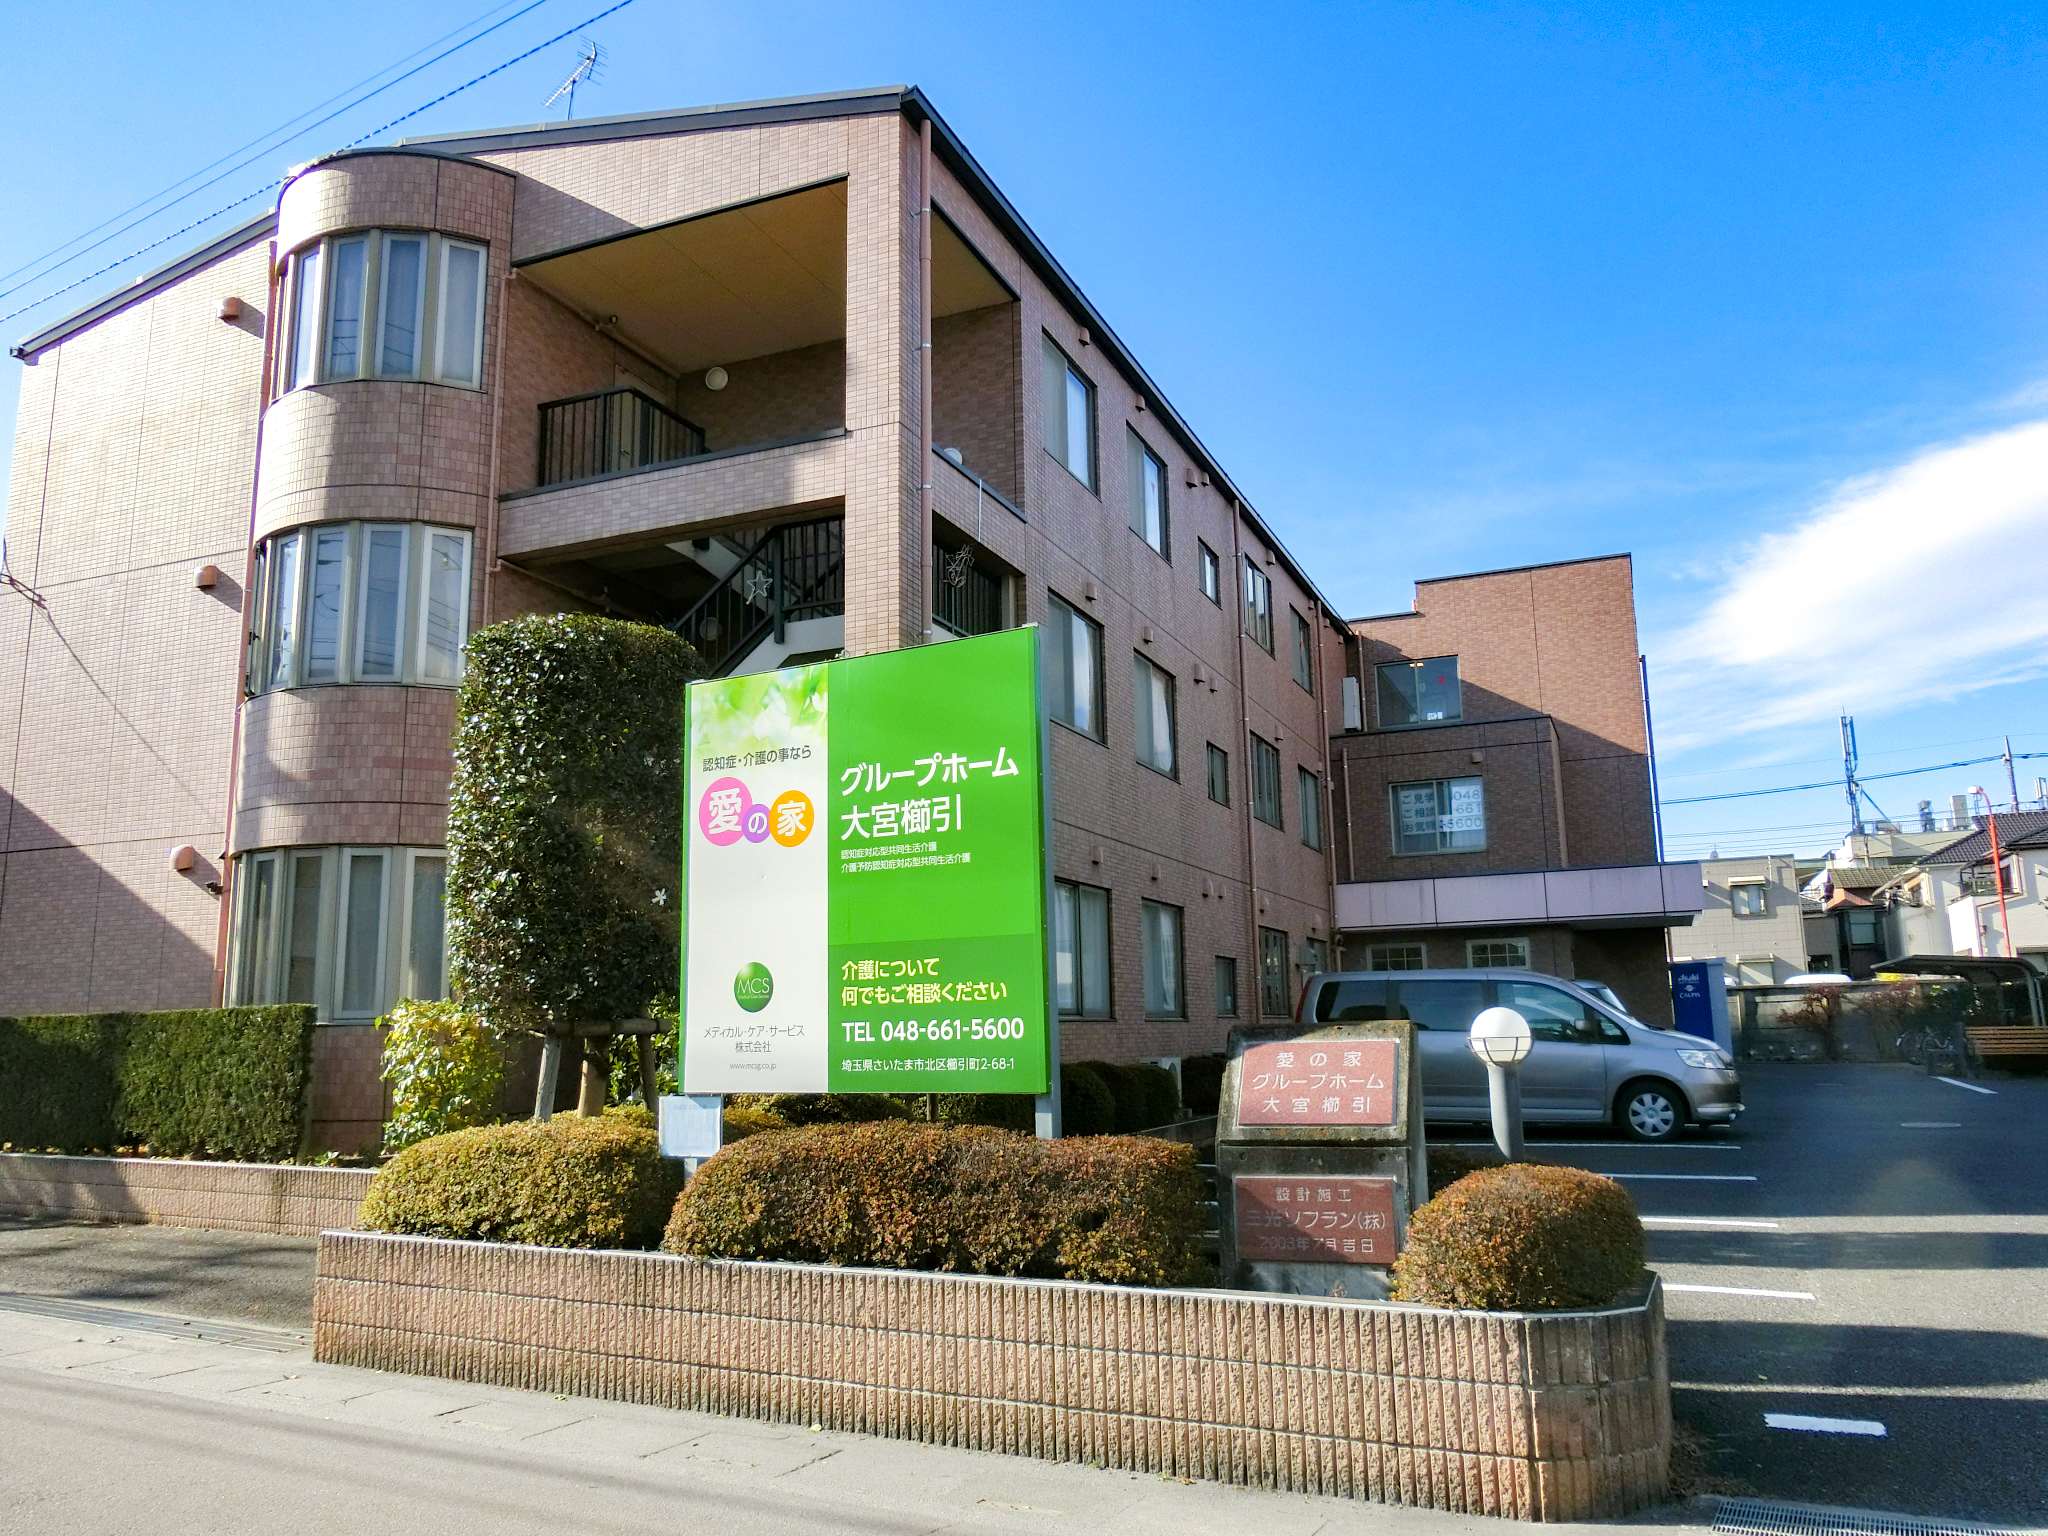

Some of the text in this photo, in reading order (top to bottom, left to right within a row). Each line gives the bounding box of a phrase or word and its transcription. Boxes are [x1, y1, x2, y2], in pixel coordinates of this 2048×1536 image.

[702, 745, 812, 773] 認知症・介護の事なら
[840, 746, 1020, 797] グループホーム
[1453, 789, 1480, 801] 048
[708, 787, 807, 837] 愛の家
[840, 793, 962, 841] 大宮櫛引
[840, 841, 938, 860] 認知症対応型共同生活介護
[841, 852, 971, 874] 介護予防認知症対応型共同生活介護
[841, 957, 940, 981] 介護について
[737, 977, 770, 994] MCS
[841, 981, 1008, 1007] 何でもご相談ください
[703, 1024, 805, 1038] メディカル・ケア・サービス
[841, 1017, 1025, 1042] TEL 048-661-5600
[735, 1040, 772, 1053] 株式会社
[841, 1057, 1015, 1072] 埼玉県さいたま市北区櫛引町2-68-1
[1276, 1051, 1362, 1068] 愛の家
[1252, 1072, 1384, 1091] グループホーム
[1262, 1096, 1370, 1113] 大宮櫛引
[1275, 1187, 1352, 1202] 設計施工
